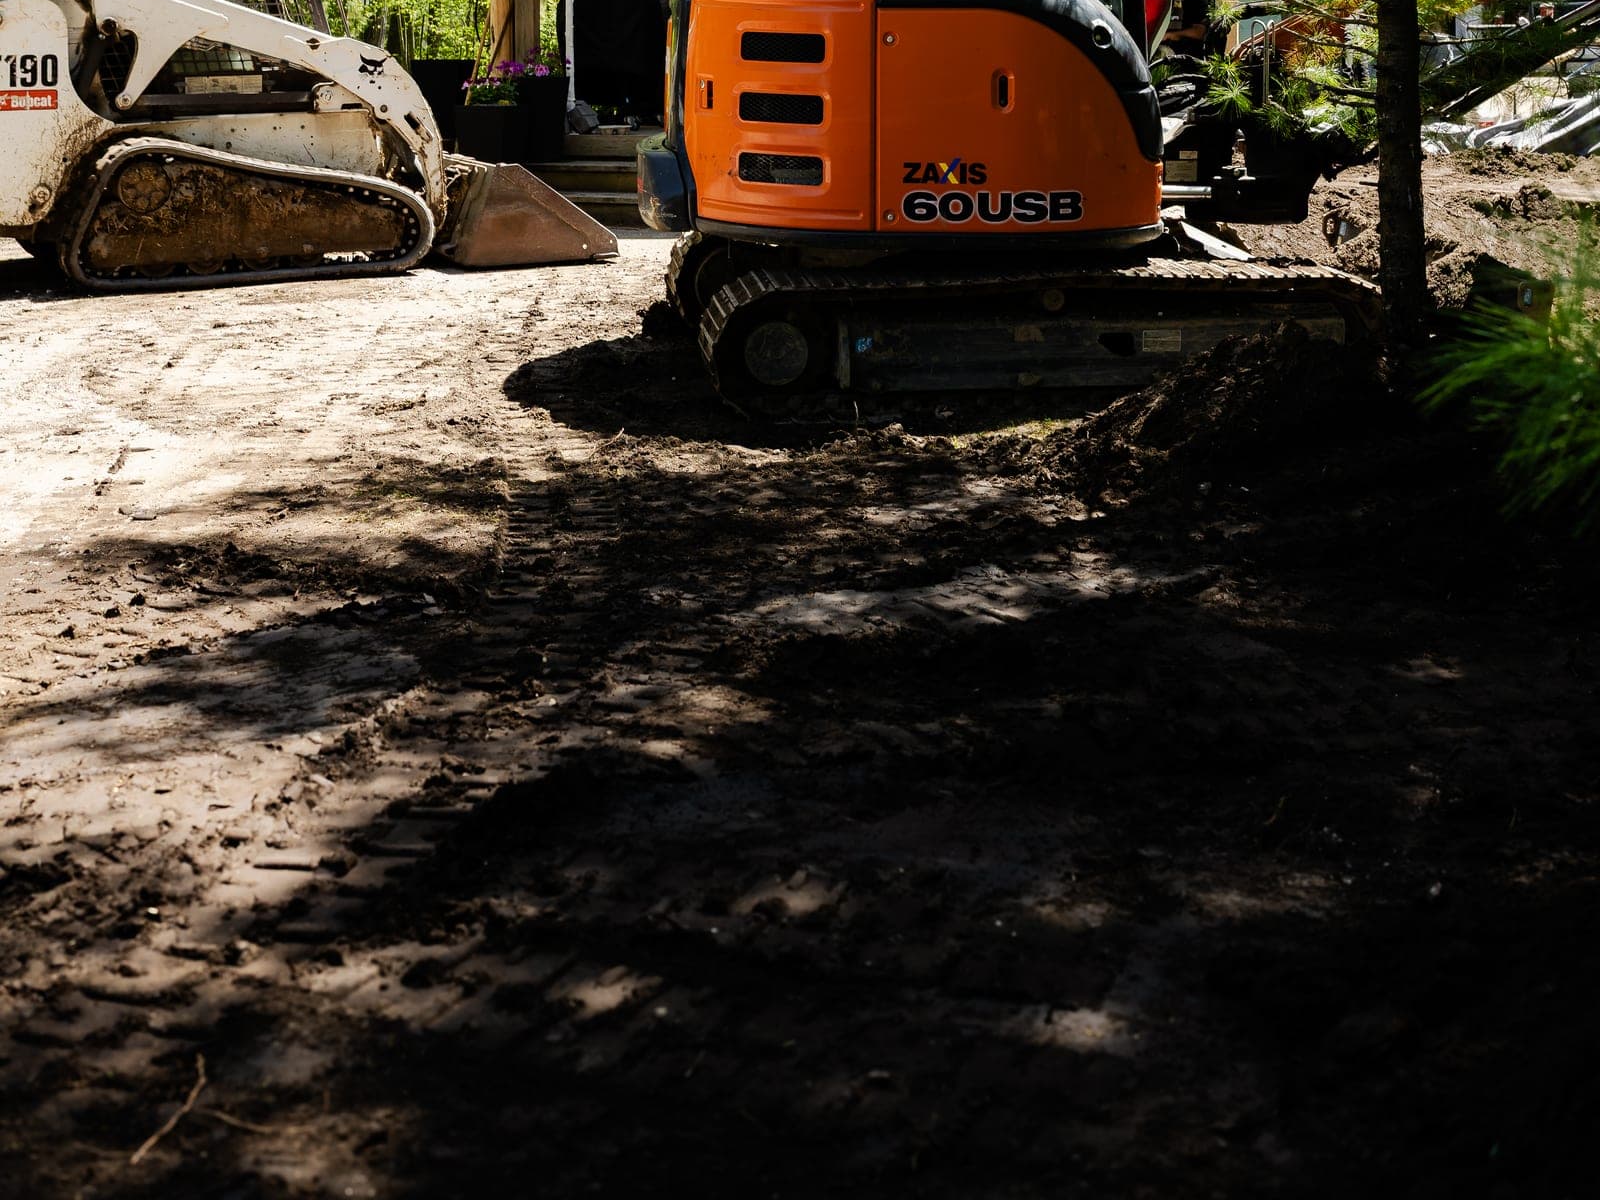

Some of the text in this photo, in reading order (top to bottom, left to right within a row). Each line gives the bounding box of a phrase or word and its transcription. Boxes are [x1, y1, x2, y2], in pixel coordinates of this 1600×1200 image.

[0, 54, 58, 87] 190
[11, 95, 52, 107] Bobcat
[903, 158, 987, 184] ZAXIS
[902, 190, 1083, 224] 60USB
